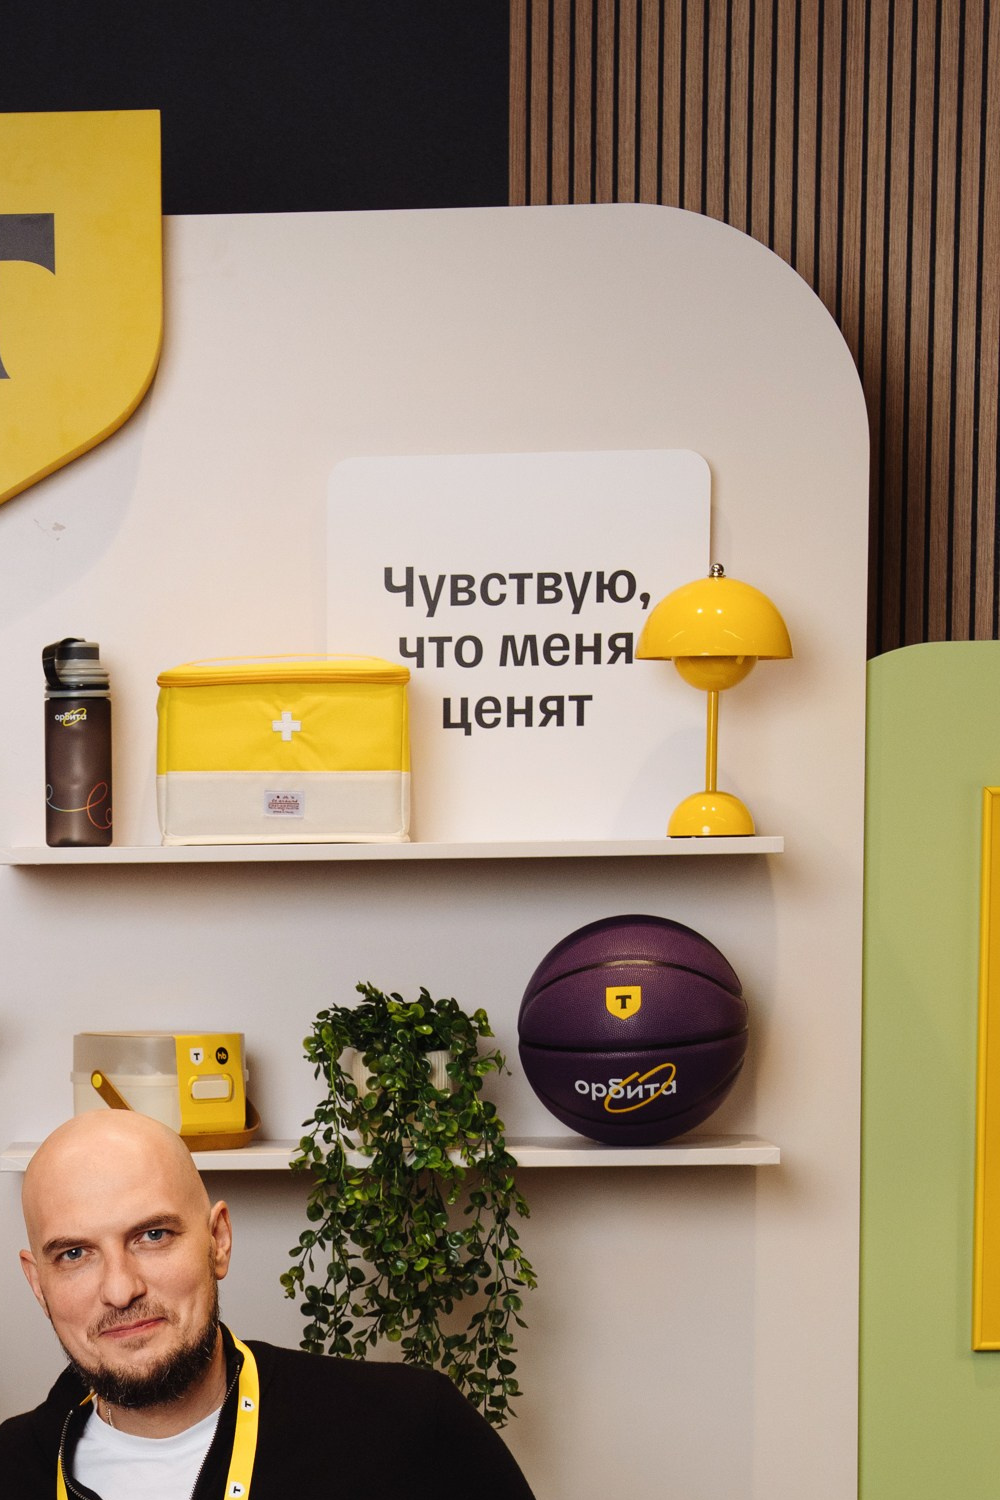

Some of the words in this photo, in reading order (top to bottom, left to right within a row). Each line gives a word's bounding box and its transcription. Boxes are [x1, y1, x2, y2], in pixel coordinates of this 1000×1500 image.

[383, 566, 651, 618] Чувствую,
[399, 635, 484, 669] что
[499, 632, 634, 667] меня
[54, 711, 88, 723] орбита
[442, 694, 593, 737] ценят
[615, 994, 632, 1010] Т
[573, 1077, 678, 1101] орбита
